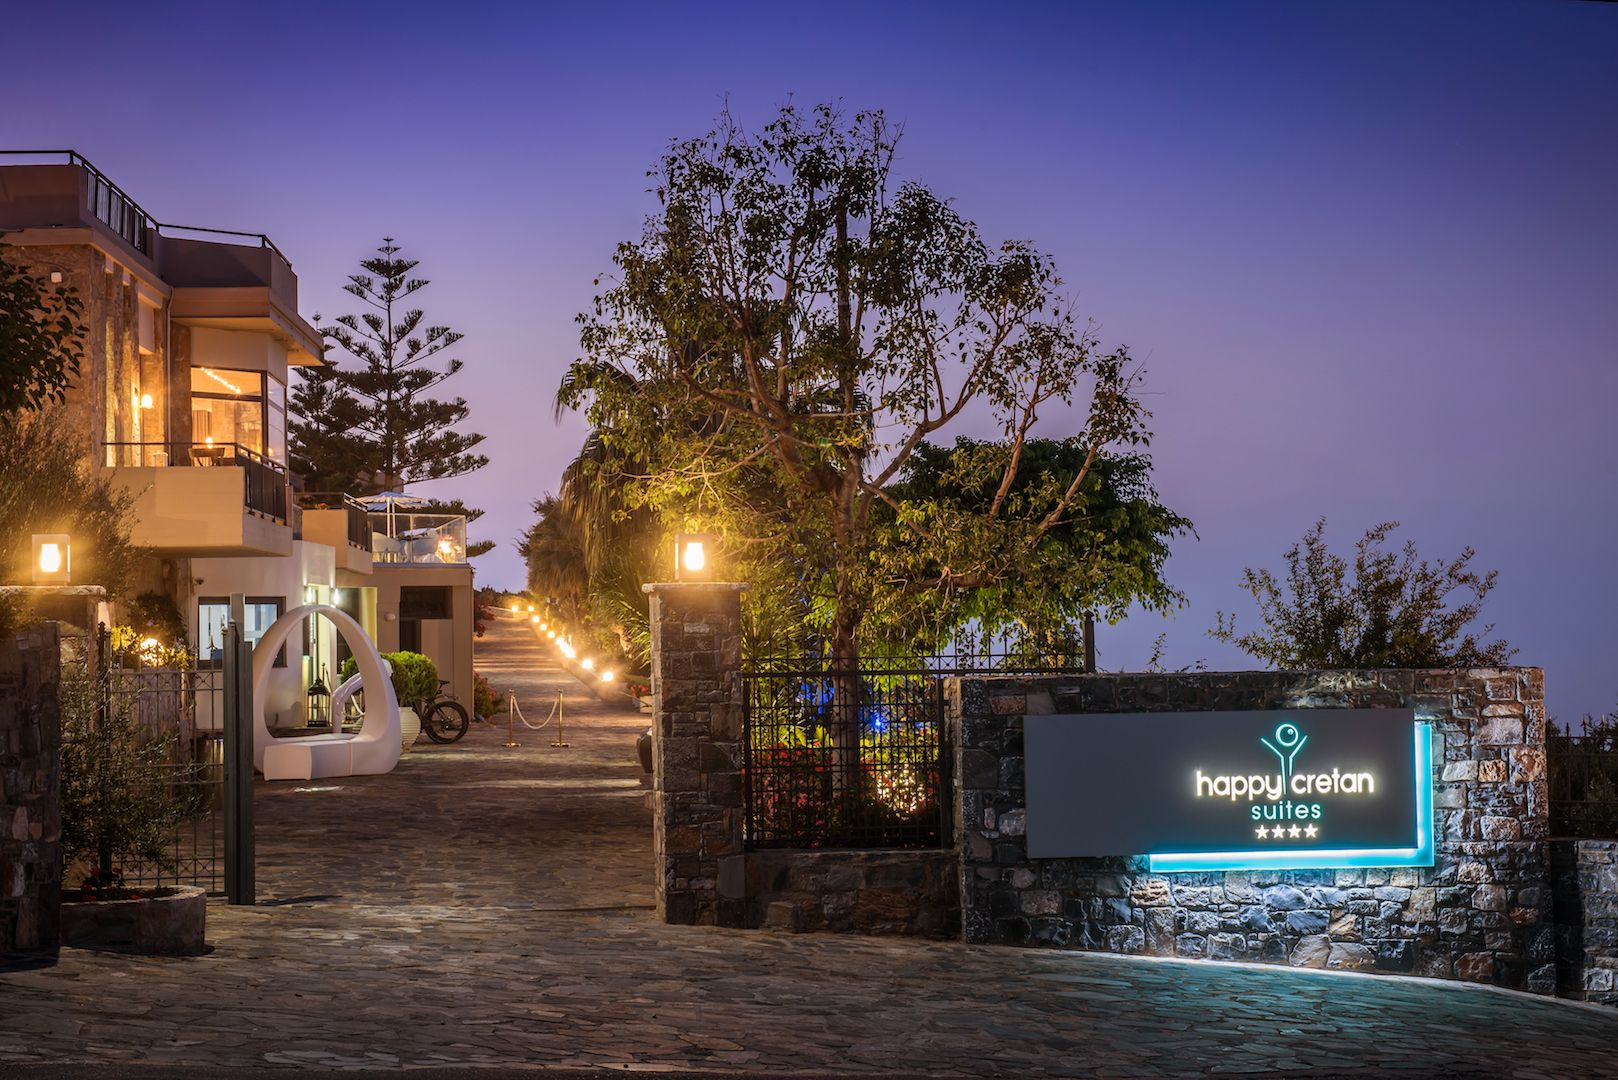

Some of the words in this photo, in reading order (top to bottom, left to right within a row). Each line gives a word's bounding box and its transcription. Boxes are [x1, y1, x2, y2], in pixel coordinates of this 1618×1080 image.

[1196, 769, 1282, 801] happy
[1291, 767, 1375, 794] cretan
[1251, 800, 1321, 820] suites
